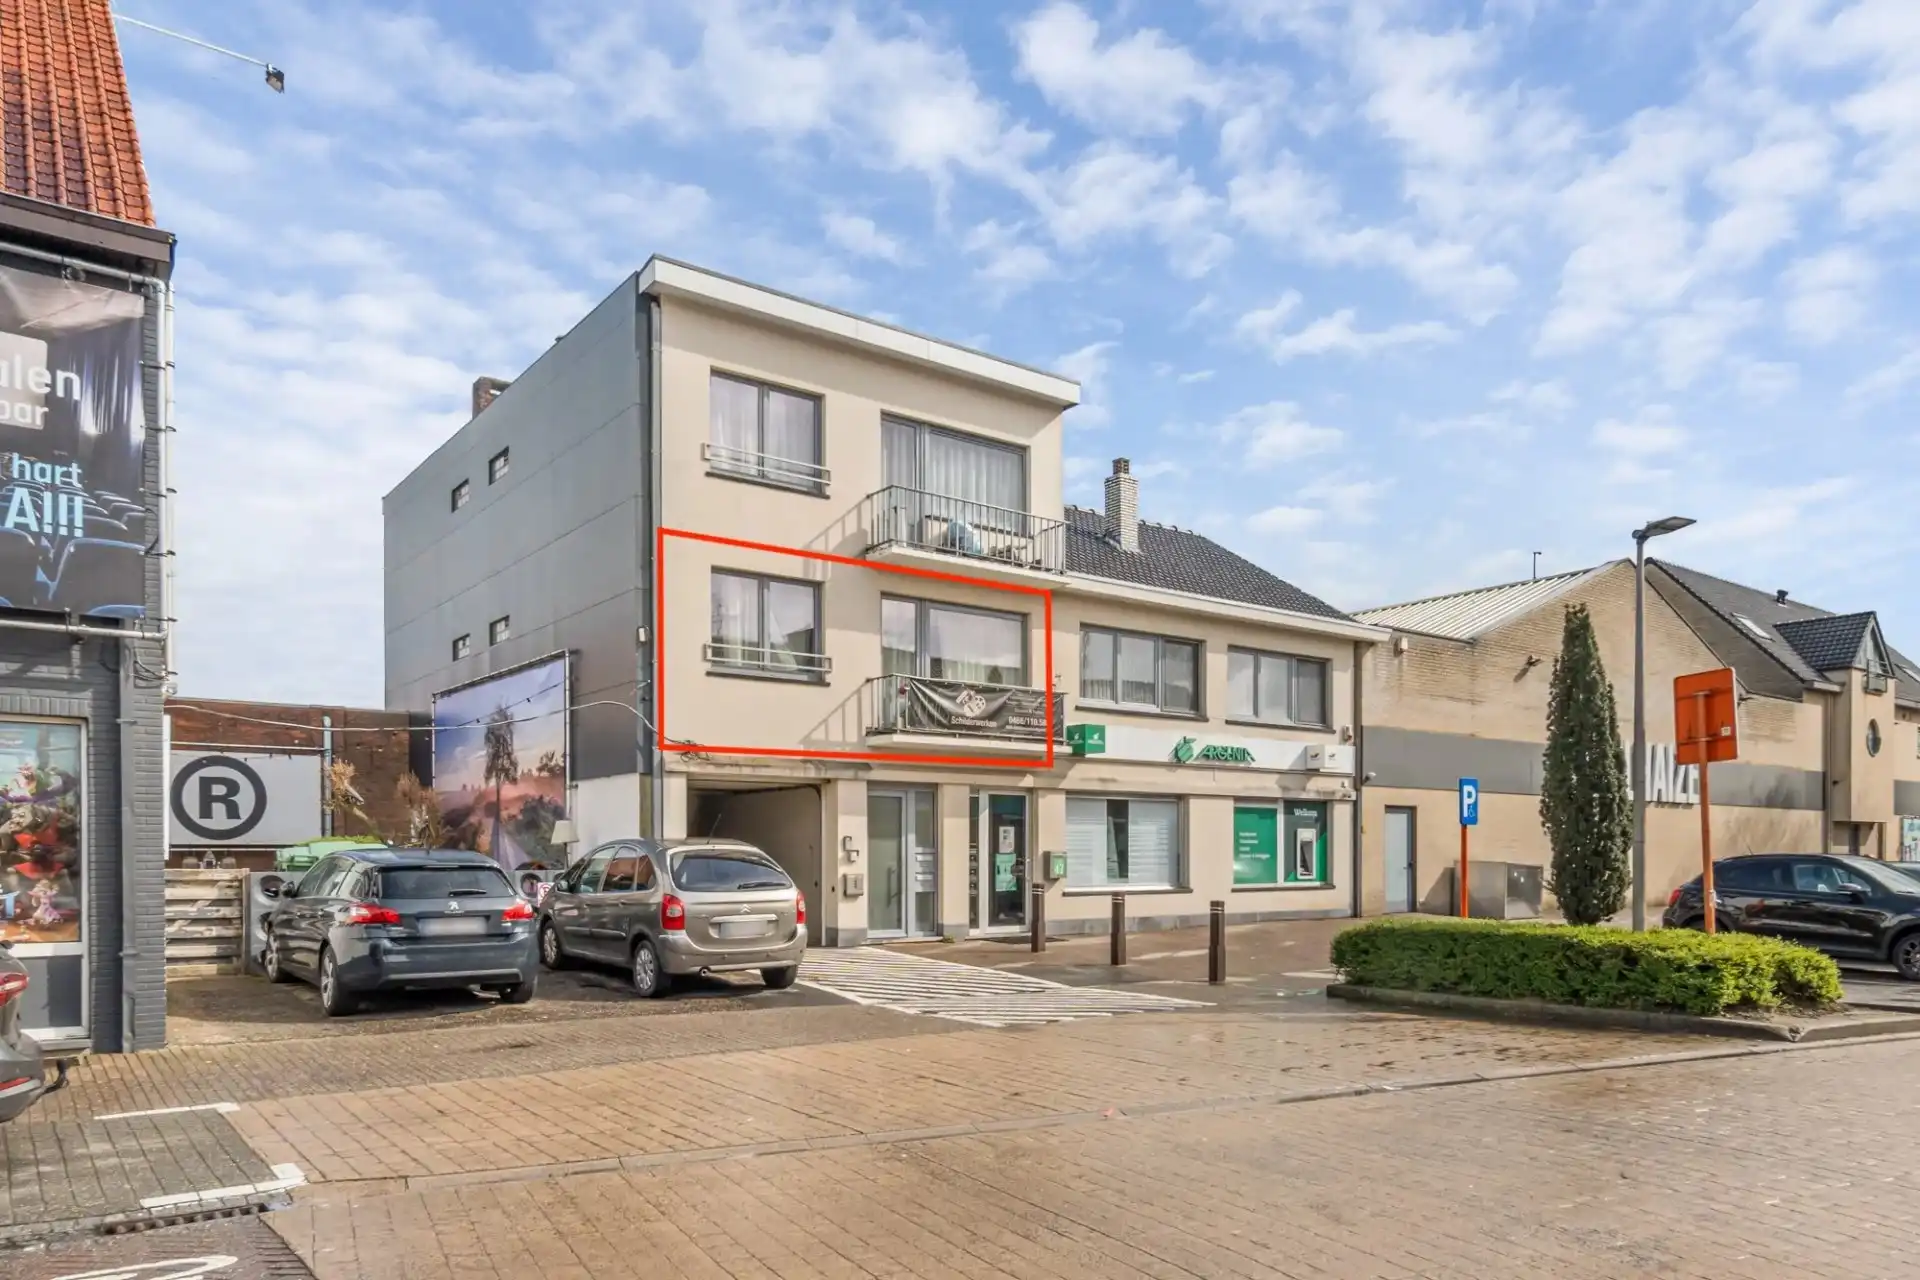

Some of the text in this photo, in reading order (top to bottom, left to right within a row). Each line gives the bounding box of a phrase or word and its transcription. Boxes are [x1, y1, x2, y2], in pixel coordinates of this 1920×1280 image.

[12, 452, 82, 488] hart
[1193, 744, 1256, 762] ARGENTA
[1463, 785, 1477, 818] P
